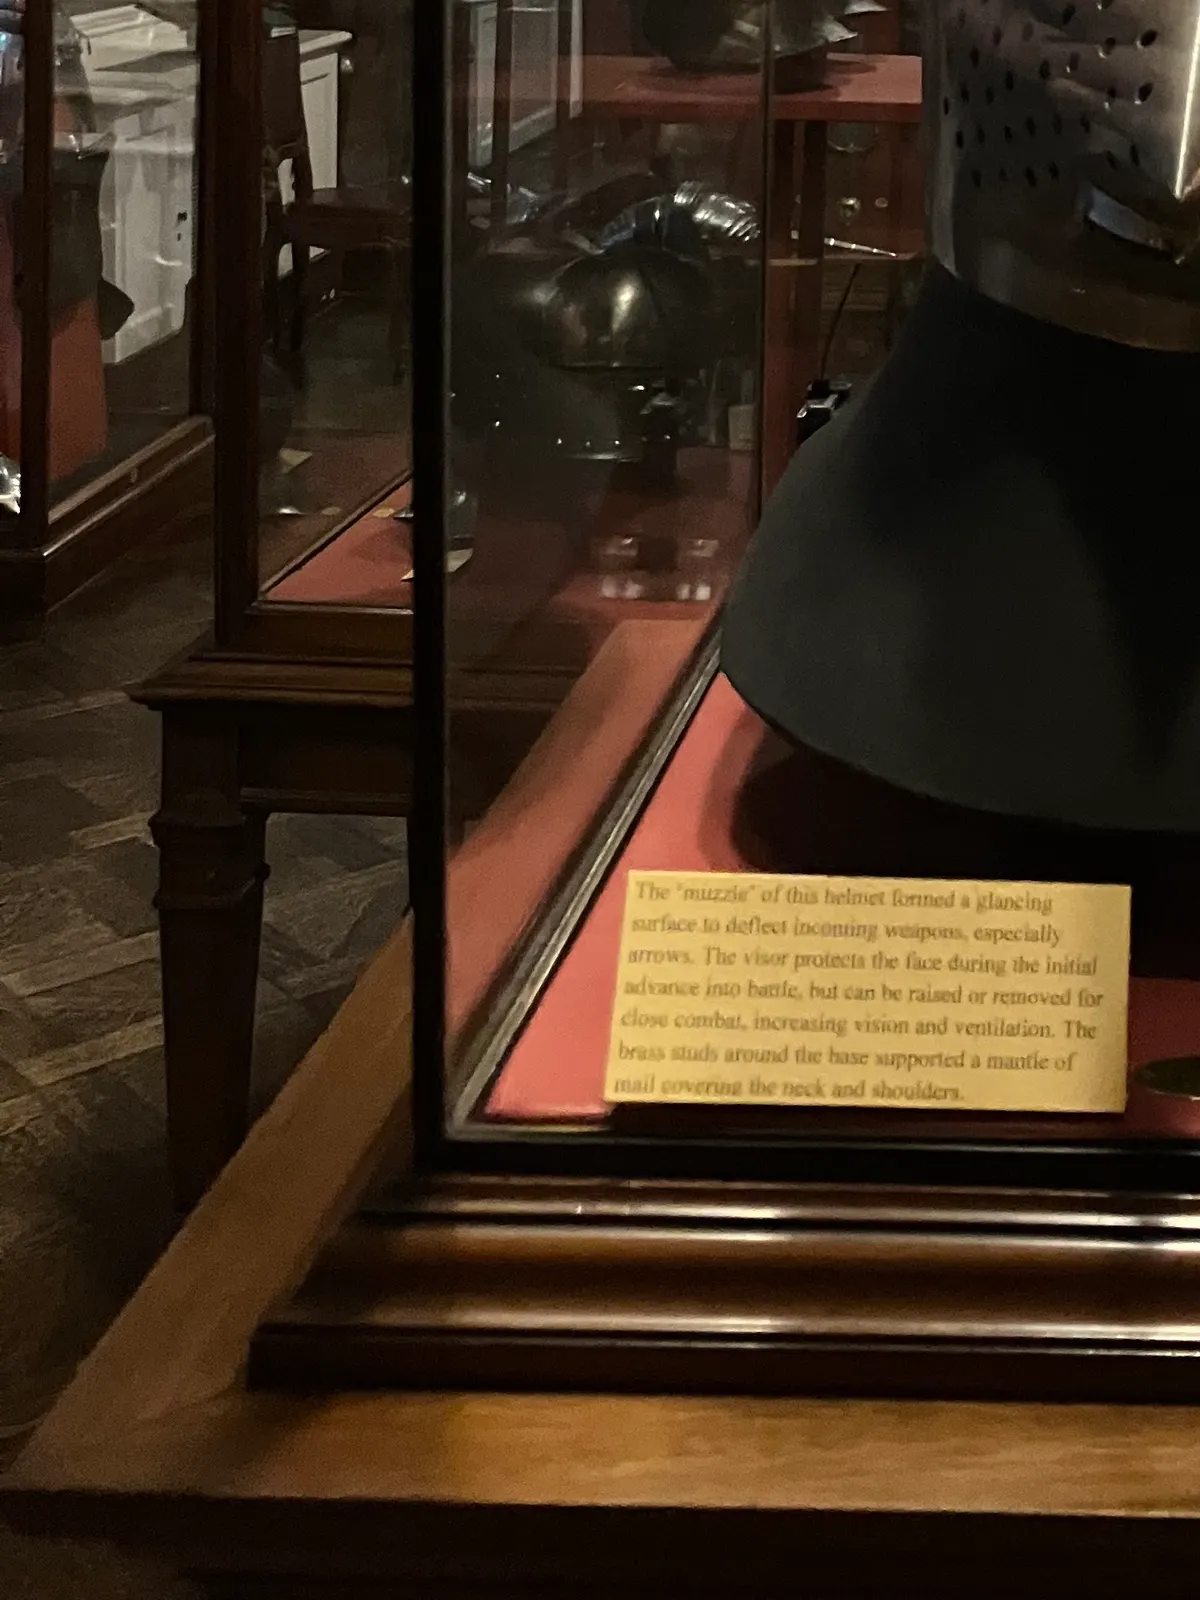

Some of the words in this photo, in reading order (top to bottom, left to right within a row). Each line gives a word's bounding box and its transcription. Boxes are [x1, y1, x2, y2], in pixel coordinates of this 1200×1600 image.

[637, 881, 670, 900] The
[761, 883, 781, 903] of
[787, 883, 819, 905] this
[824, 886, 885, 907] helmet
[892, 888, 955, 909] formed
[960, 895, 970, 909] a
[976, 891, 1053, 916] glancing
[632, 913, 697, 934] surface
[703, 916, 720, 933] to
[725, 915, 788, 936] deflect
[794, 917, 878, 942] incoming
[973, 921, 1060, 948] especially
[628, 949, 694, 964] arrows.
[704, 946, 737, 966] The
[744, 947, 787, 967] visor
[794, 949, 866, 971] protects
[872, 951, 898, 970] the
[906, 951, 942, 971] face
[947, 953, 1006, 977] during
[1012, 955, 1040, 973] the
[1045, 954, 1098, 976] initial
[624, 975, 700, 996] advance
[705, 977, 741, 998] into
[747, 977, 803, 1000] battle,
[809, 981, 838, 1000] but
[843, 985, 875, 1000] can
[881, 983, 902, 1001] be
[909, 984, 962, 1004] raised
[968, 989, 988, 1004] or
[992, 988, 1072, 1007] removed
[1077, 987, 1104, 1008] for
[620, 1007, 669, 1029] close
[674, 1010, 748, 1030] combat,
[753, 1011, 847, 1037] increasing
[854, 1013, 909, 1034] vision
[915, 1015, 949, 1036] and
[955, 1017, 1055, 1039] ventilation.
[1063, 1019, 1097, 1039] The
[619, 1040, 666, 1062] brass
[670, 1043, 718, 1062] studs
[724, 1046, 789, 1064] around
[794, 1045, 822, 1064] the
[828, 1045, 869, 1065] base
[875, 1050, 965, 1072] supported
[970, 1054, 981, 1069] a
[986, 1051, 1049, 1071] mantle
[1054, 1051, 1078, 1071] of
[614, 1074, 656, 1094] mail
[661, 1076, 742, 1097] covering
[749, 1074, 777, 1096] the
[782, 1078, 827, 1098] neck
[832, 1080, 865, 1098] and
[871, 1078, 964, 1100] shoulders.
